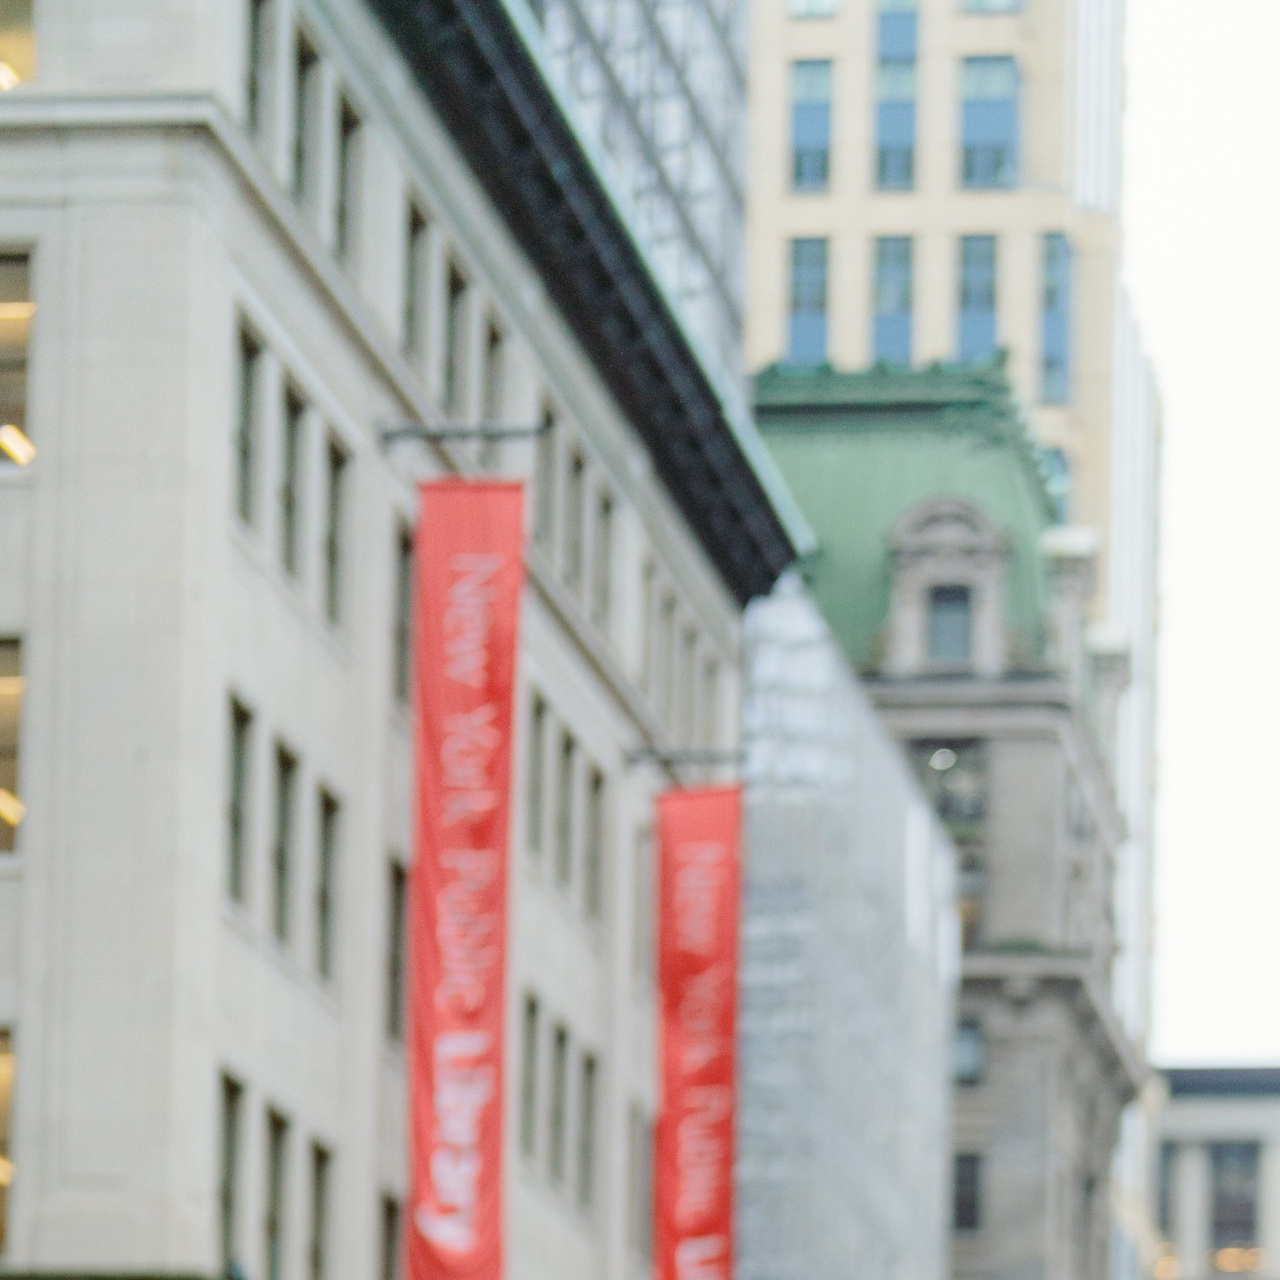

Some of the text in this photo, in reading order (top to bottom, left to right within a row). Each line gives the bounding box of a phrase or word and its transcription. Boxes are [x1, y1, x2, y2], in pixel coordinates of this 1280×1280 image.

[414, 552, 503, 1253] New York Public Library
